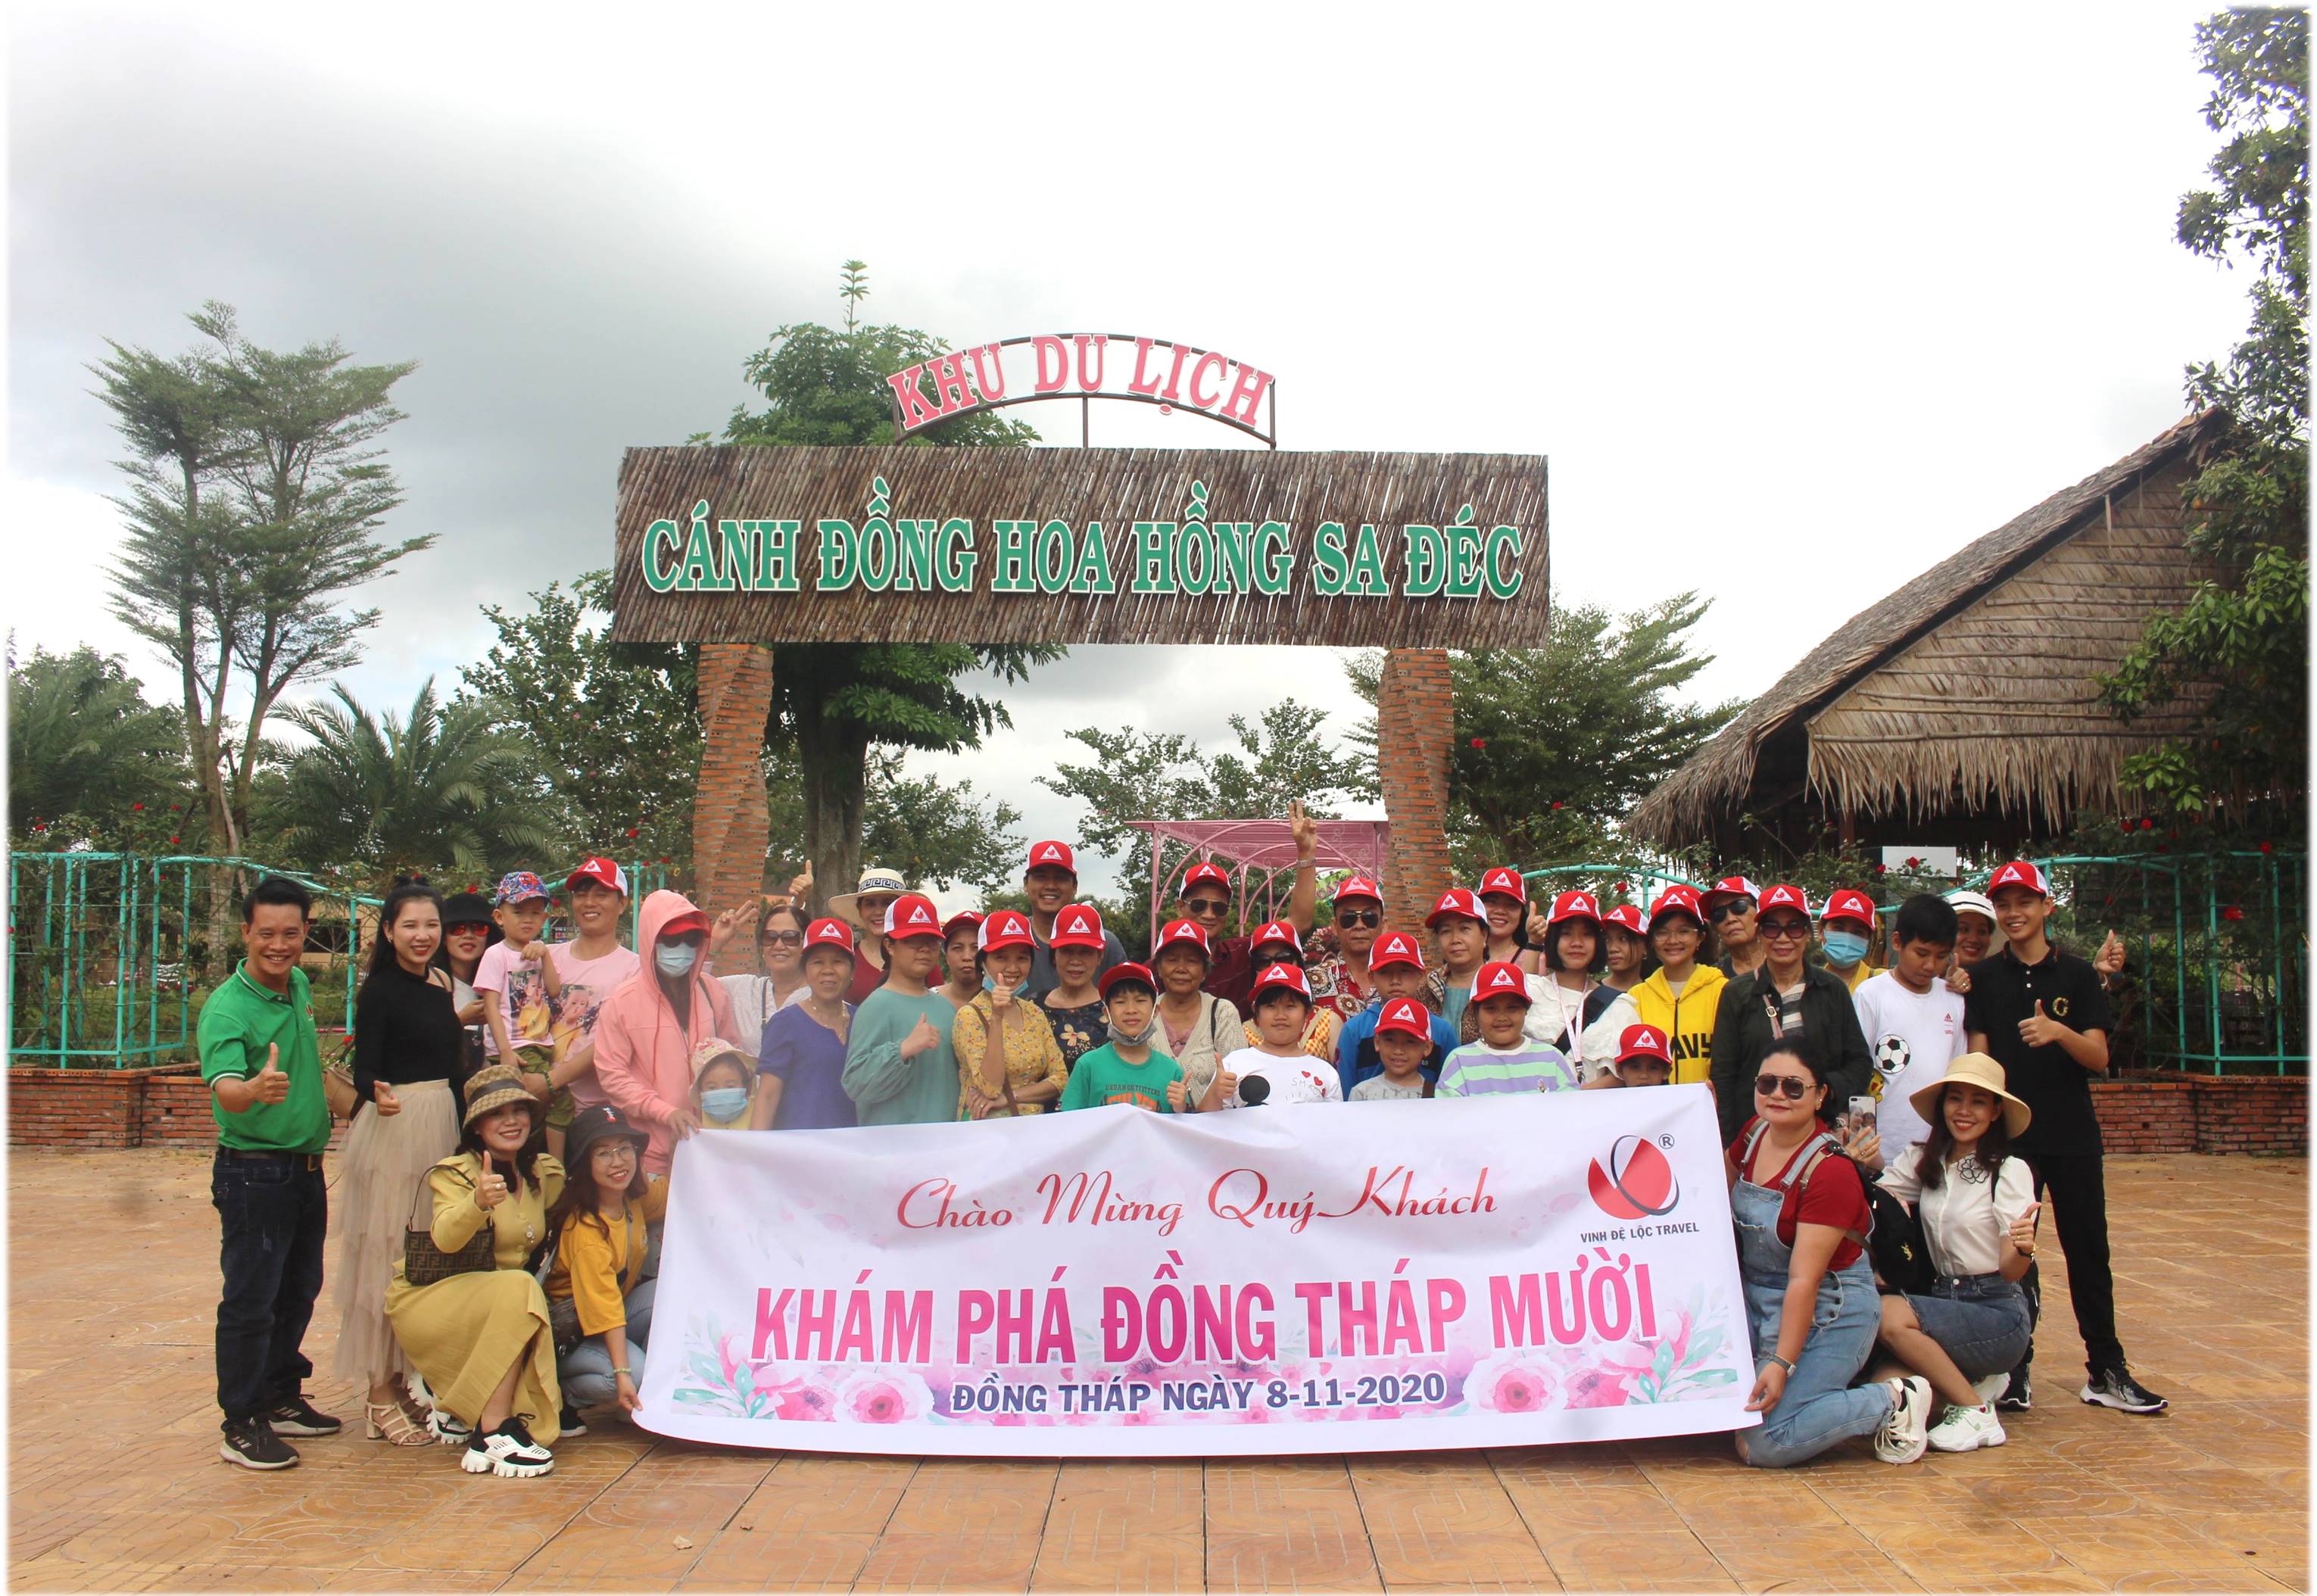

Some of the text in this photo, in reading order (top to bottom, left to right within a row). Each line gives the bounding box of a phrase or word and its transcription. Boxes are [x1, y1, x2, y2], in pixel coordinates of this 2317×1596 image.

[889, 335, 1274, 430] KHU DU LỊCH
[642, 477, 1523, 599] CÁNH ĐỒNG HOA HỒNG SA ĐÉC
[897, 1165, 1498, 1236] Chào Mừng Quý Khách
[1580, 1222, 1700, 1243] VINH ĐỆ LỘC TRAVEL
[751, 1246, 1657, 1364] KHÁM PHÁ ĐỒNG THÁP MƯỜI
[953, 1372, 1445, 1412] ĐỒNG THÁP NGÀY 8-11-2020
